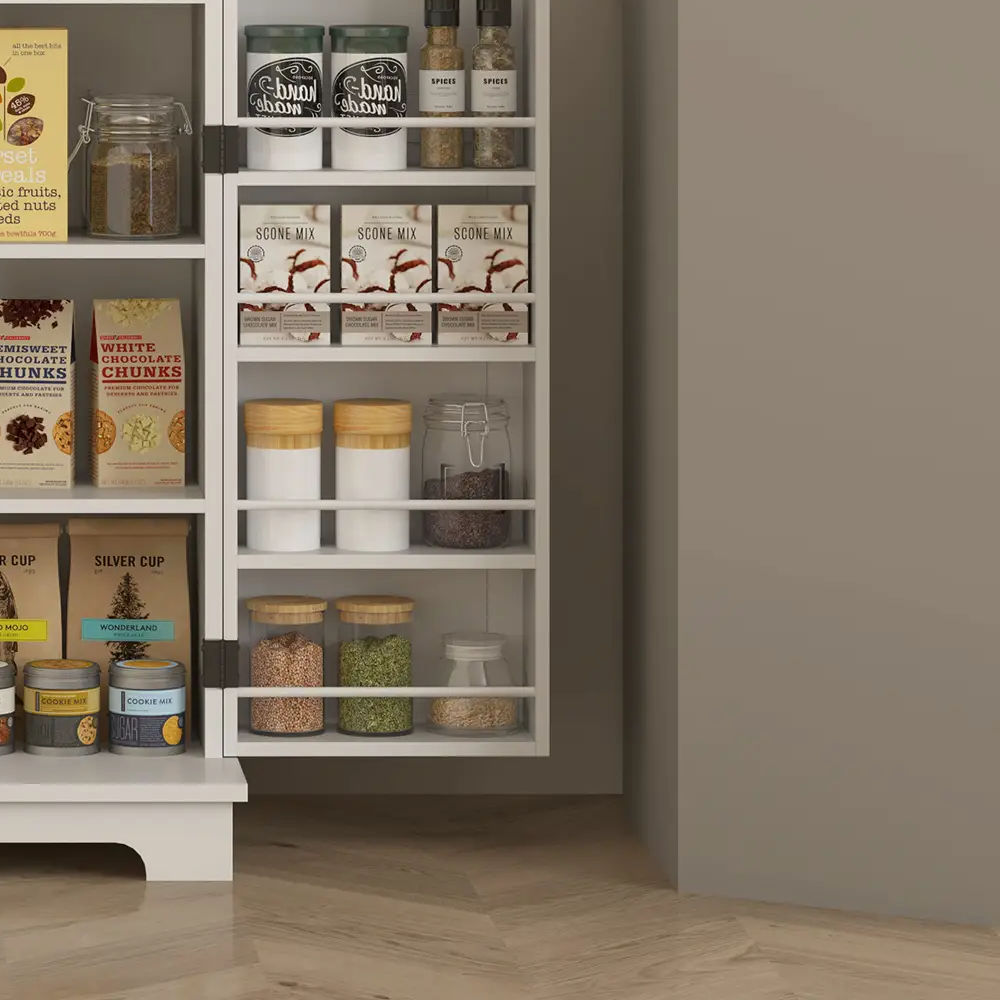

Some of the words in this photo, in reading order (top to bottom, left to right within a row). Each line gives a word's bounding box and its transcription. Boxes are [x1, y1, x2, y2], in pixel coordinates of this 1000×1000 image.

[17, 186, 61, 200] fruits,
[23, 201, 57, 211] nuts
[255, 227, 291, 240] SCONE
[295, 227, 315, 240] MIX
[357, 227, 392, 240] SCONE
[397, 227, 417, 240] MIX
[453, 227, 490, 240] SCONE
[493, 227, 513, 240] MIX
[100, 343, 156, 353] WHITE
[101, 354, 182, 364] CHOCOLATE
[101, 366, 182, 378] CHUNKS
[11, 554, 36, 566] CUP
[94, 555, 136, 567] SILVER
[140, 556, 165, 568] CUP
